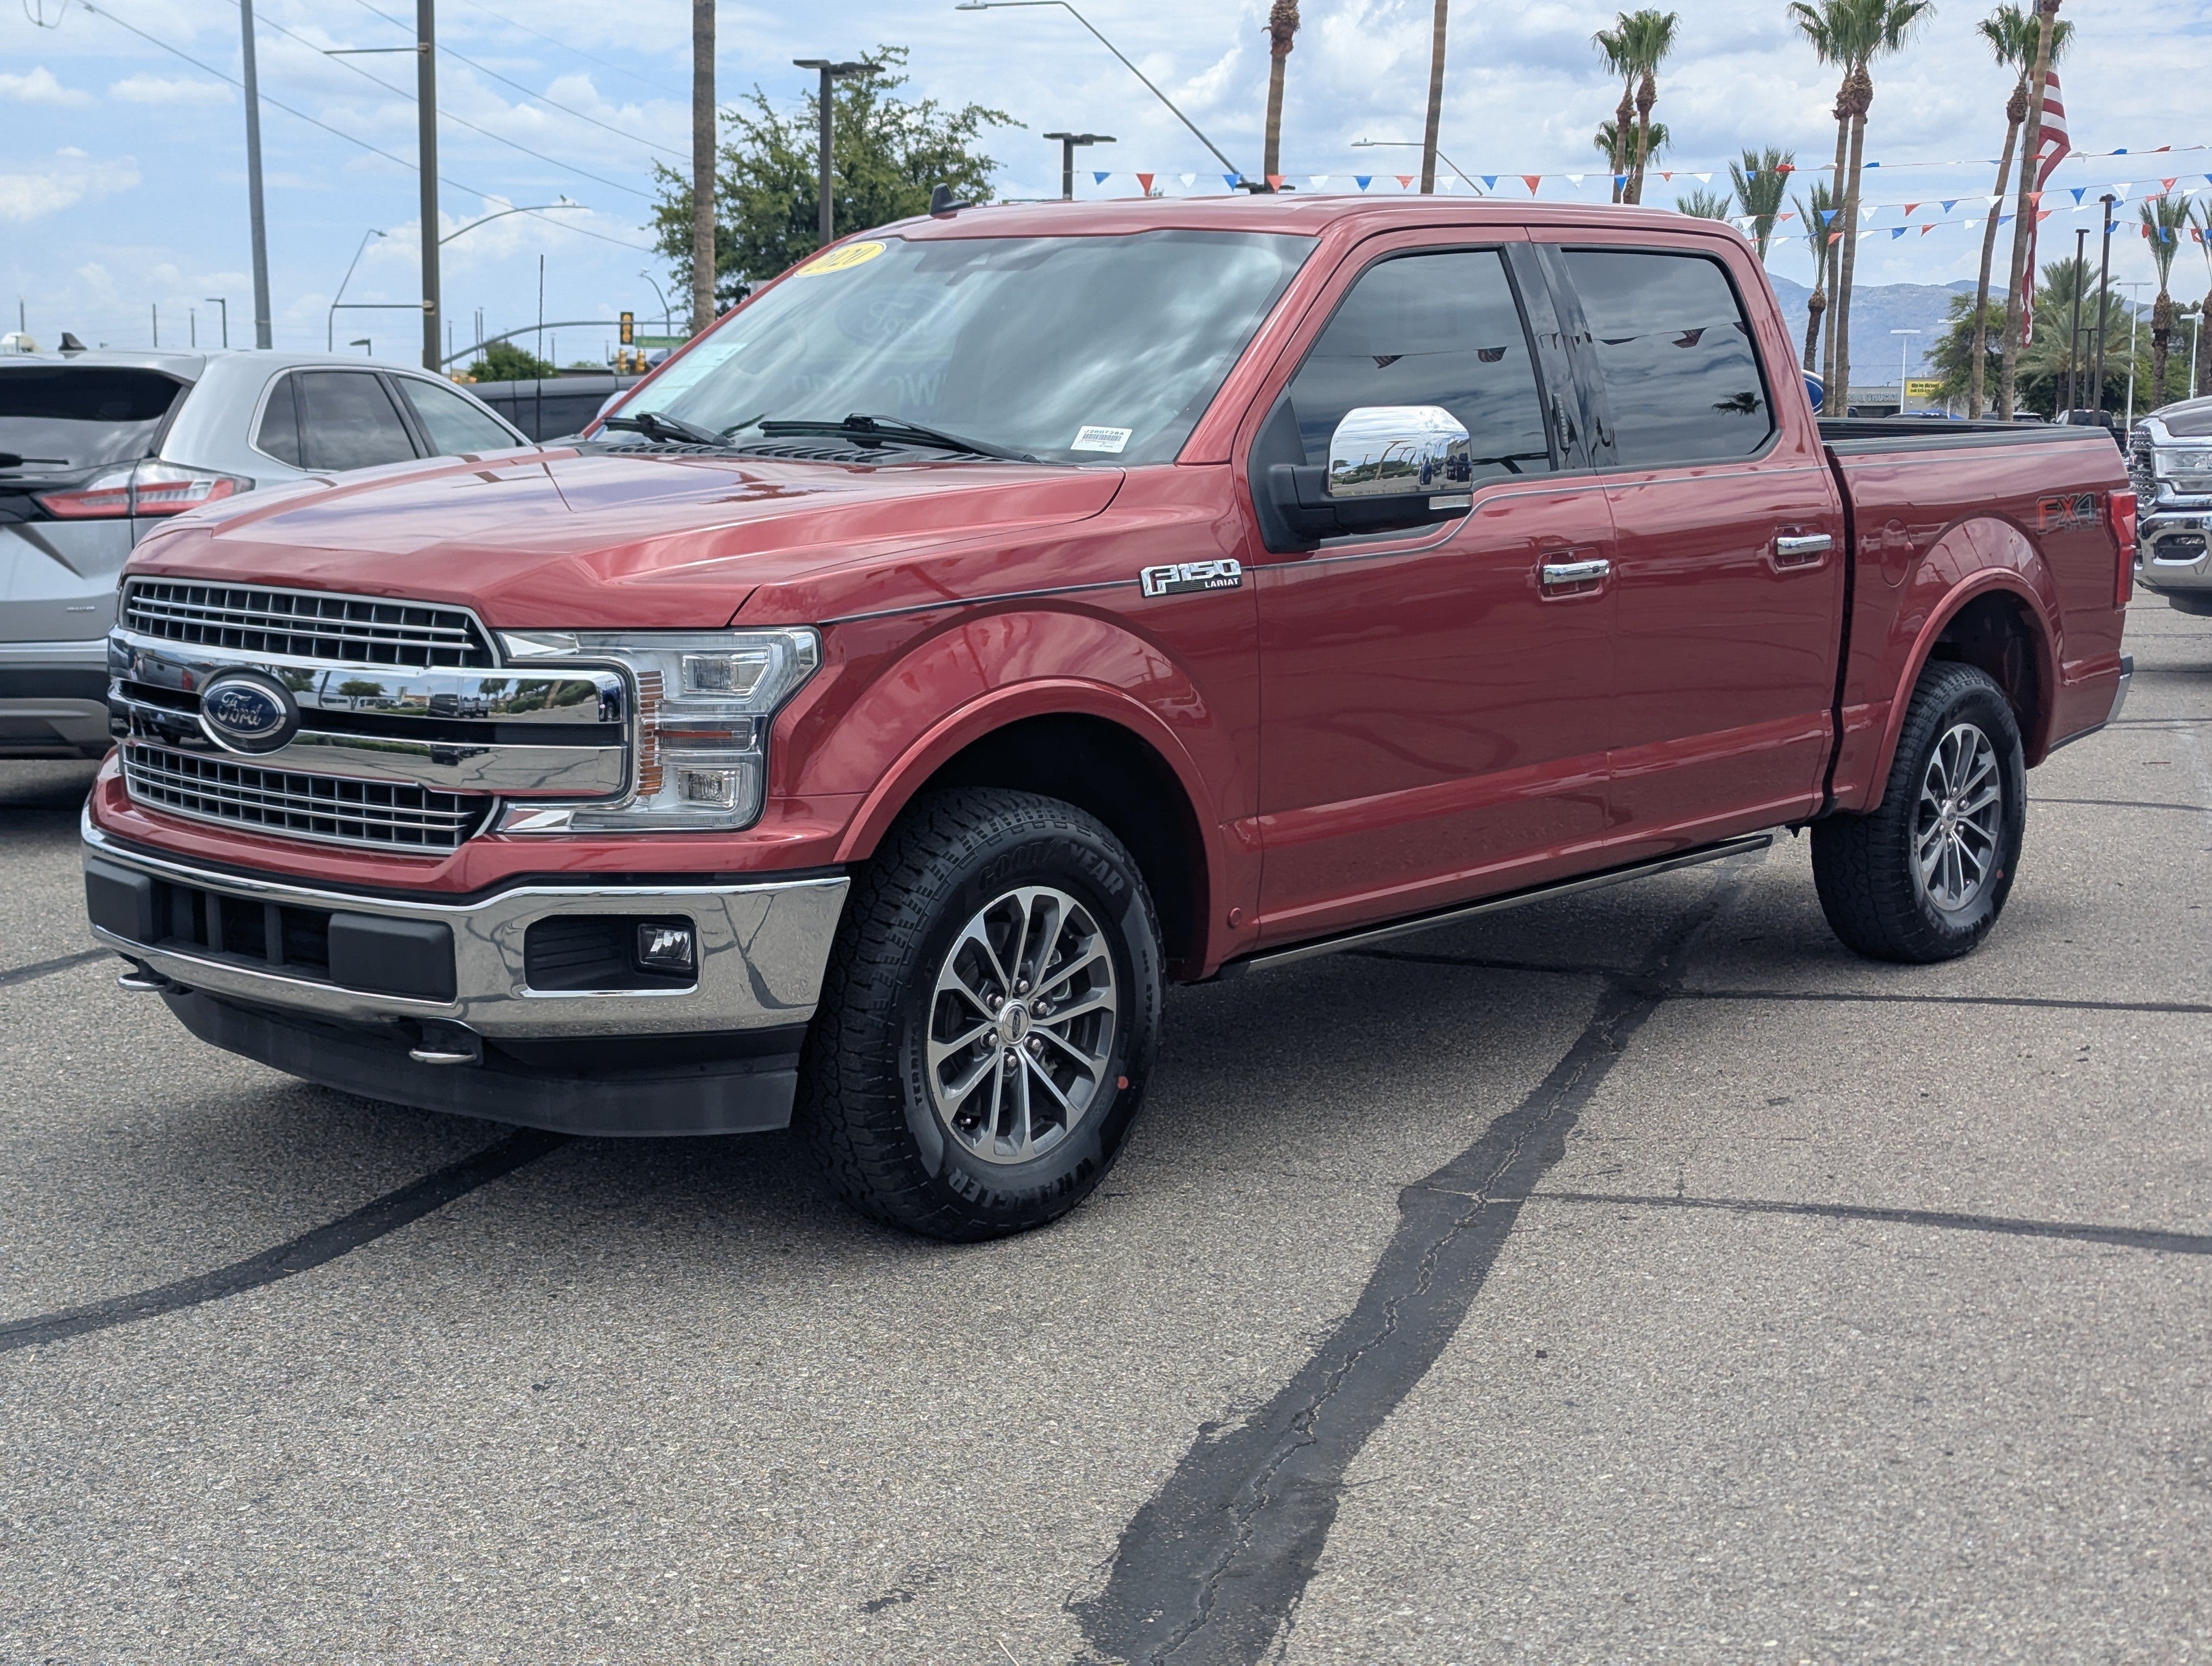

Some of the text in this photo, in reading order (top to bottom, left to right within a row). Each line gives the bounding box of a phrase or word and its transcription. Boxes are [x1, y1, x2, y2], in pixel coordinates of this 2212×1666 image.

[1867, 392, 1900, 402] TRUCKS
[2036, 492, 2096, 535] FX4
[1205, 578, 1239, 588] LARIAT
[217, 691, 263, 726] Ford
